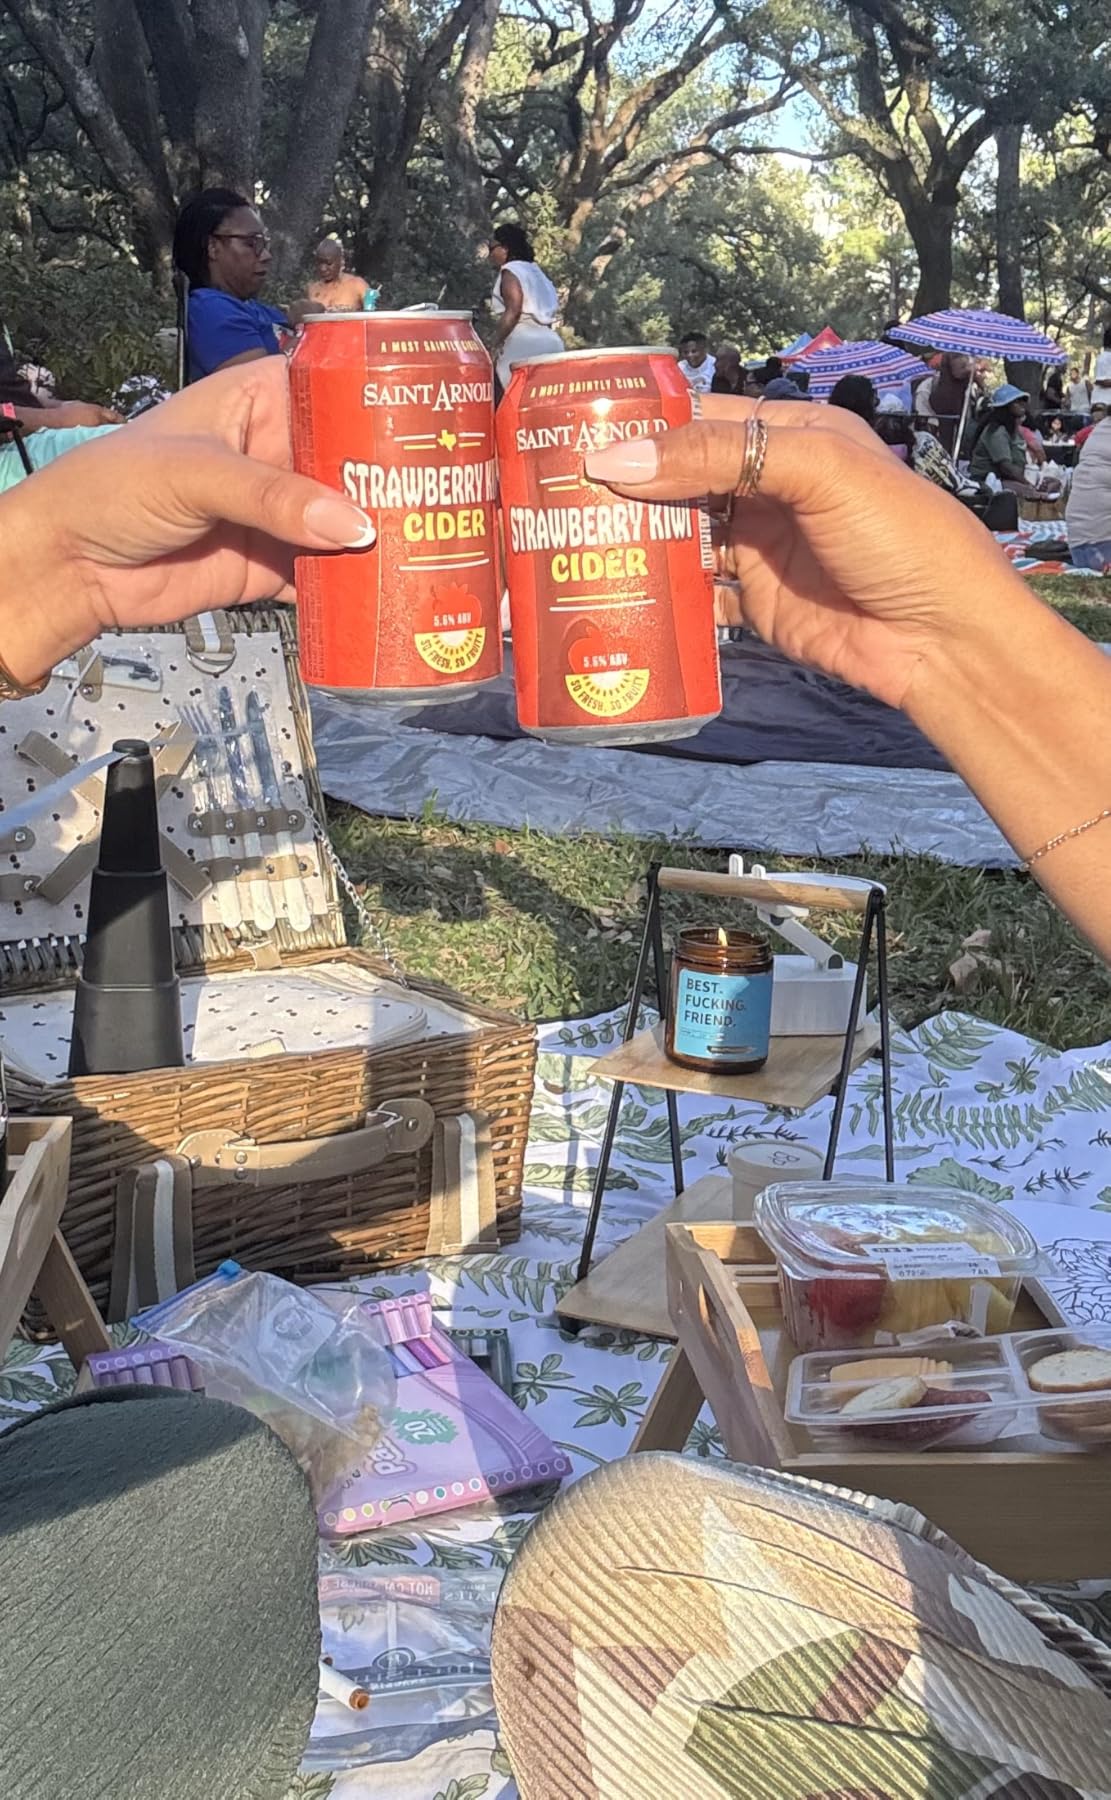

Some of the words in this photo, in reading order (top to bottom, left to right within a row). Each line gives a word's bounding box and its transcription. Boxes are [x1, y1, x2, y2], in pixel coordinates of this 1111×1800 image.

[380, 341, 388, 353] A
[391, 341, 419, 353] MOST
[423, 340, 460, 352] SAINTLY
[363, 383, 434, 407] SAINT
[530, 387, 537, 398] A
[538, 384, 565, 396] MOST
[568, 379, 612, 394] SAINTLY
[616, 376, 647, 390] CIDER
[516, 425, 574, 452] SAINT
[343, 460, 484, 509] STRAWBERRY
[402, 508, 486, 542] CIDER
[509, 502, 644, 554] STRAWBERRY
[647, 502, 693, 541] KIWI
[550, 546, 649, 584] CIDER
[457, 611, 472, 625] ABV
[420, 639, 432, 652] SO
[455, 656, 465, 668] SO
[466, 632, 483, 662] FRUITY
[609, 652, 628, 666] ABV
[570, 679, 582, 693] SO
[610, 699, 623, 711] SO
[622, 676, 645, 705] FRUITY
[686, 978, 723, 994] BEST.
[685, 994, 747, 1012] FUCKING.
[683, 1010, 737, 1028] FRIEND.
[404, 1420, 436, 1441] 20
